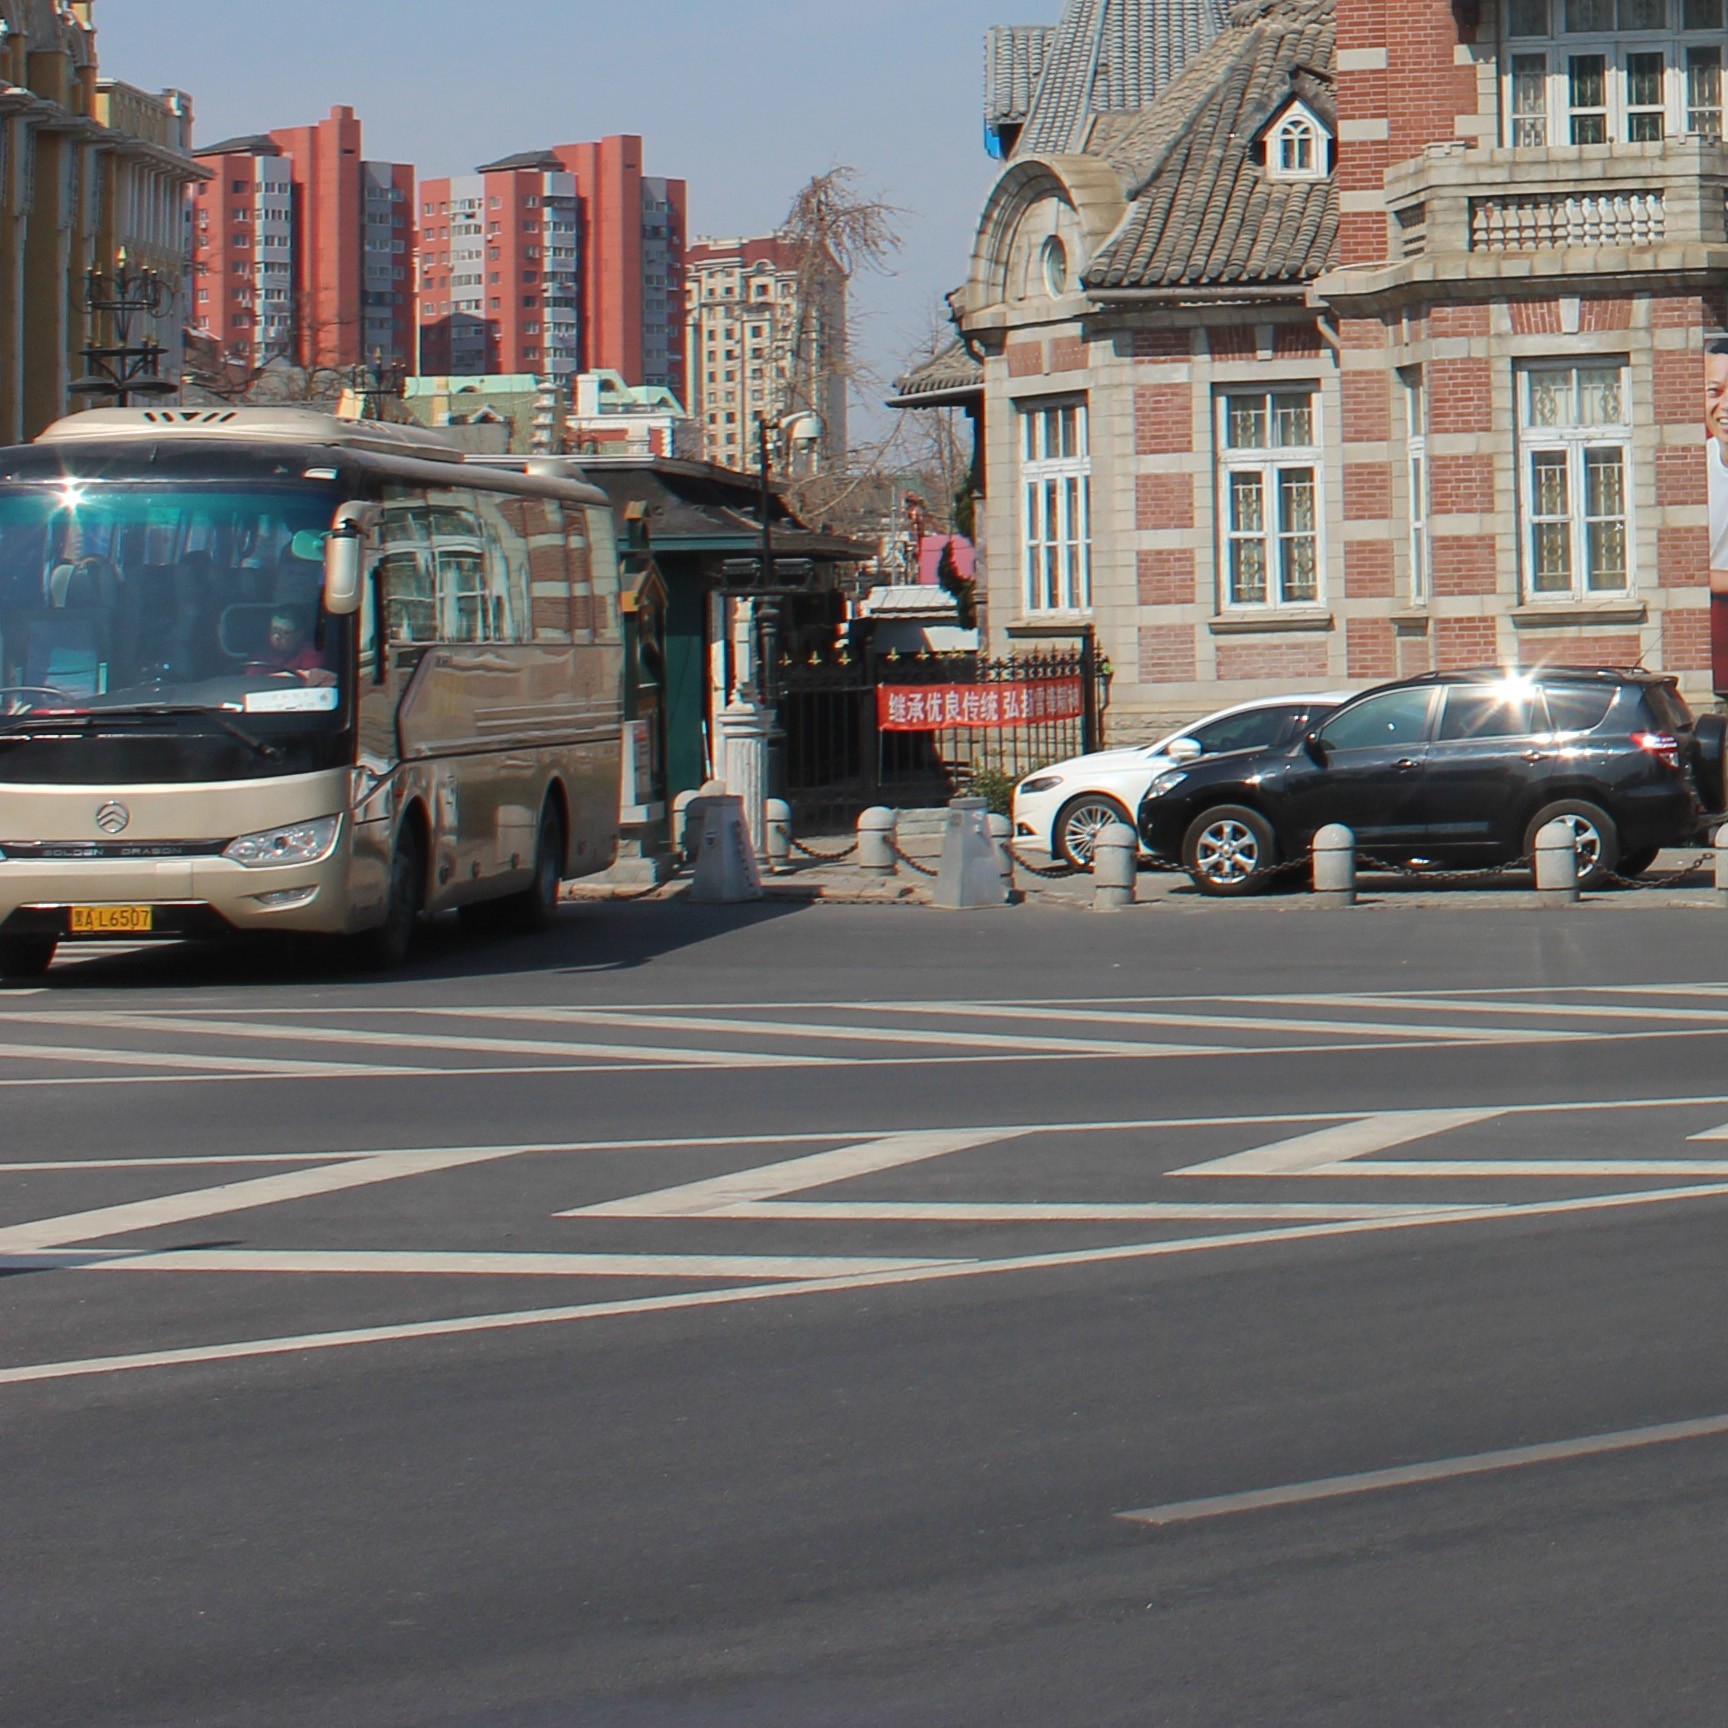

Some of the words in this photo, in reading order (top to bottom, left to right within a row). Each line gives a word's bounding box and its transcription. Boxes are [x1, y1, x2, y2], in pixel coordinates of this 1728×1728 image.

[889, 691, 998, 722] 继承优良传统
